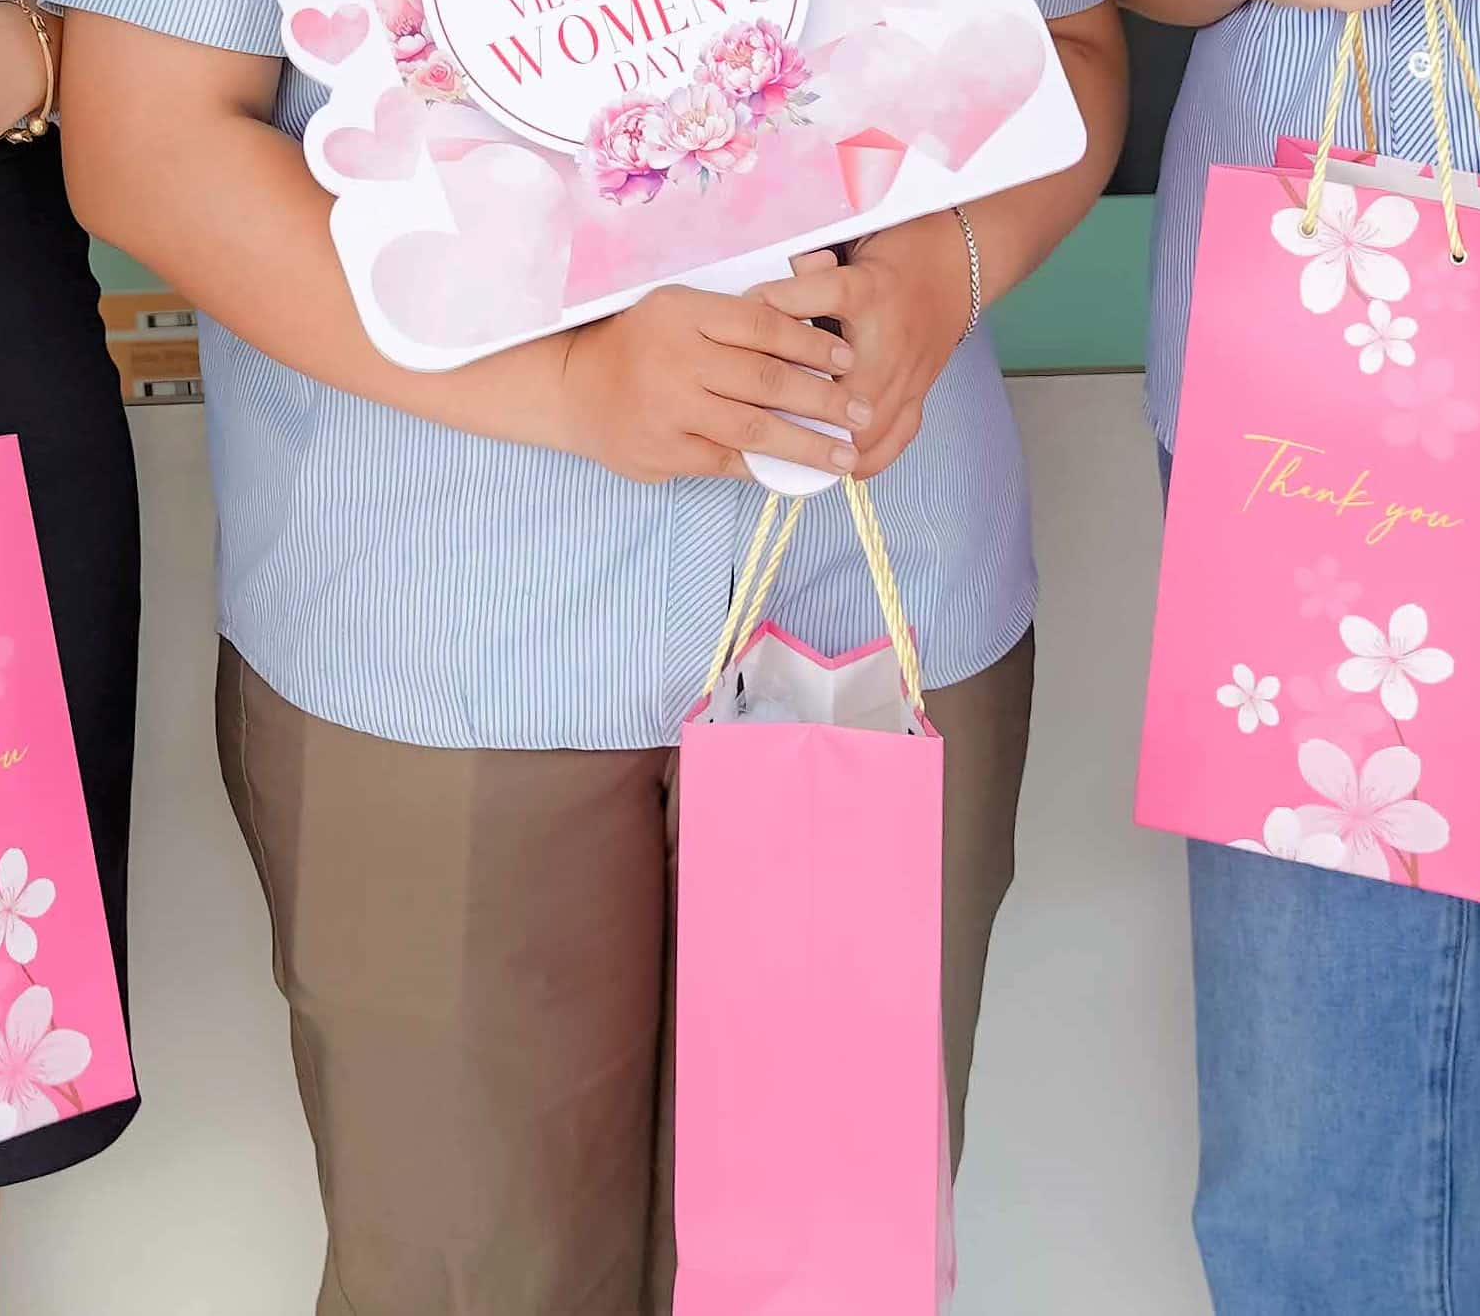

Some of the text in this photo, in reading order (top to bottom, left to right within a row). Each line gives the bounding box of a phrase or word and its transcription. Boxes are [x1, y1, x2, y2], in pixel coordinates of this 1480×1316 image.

[613, 41, 686, 92] DAY
[1243, 434, 1465, 545] Thank you
